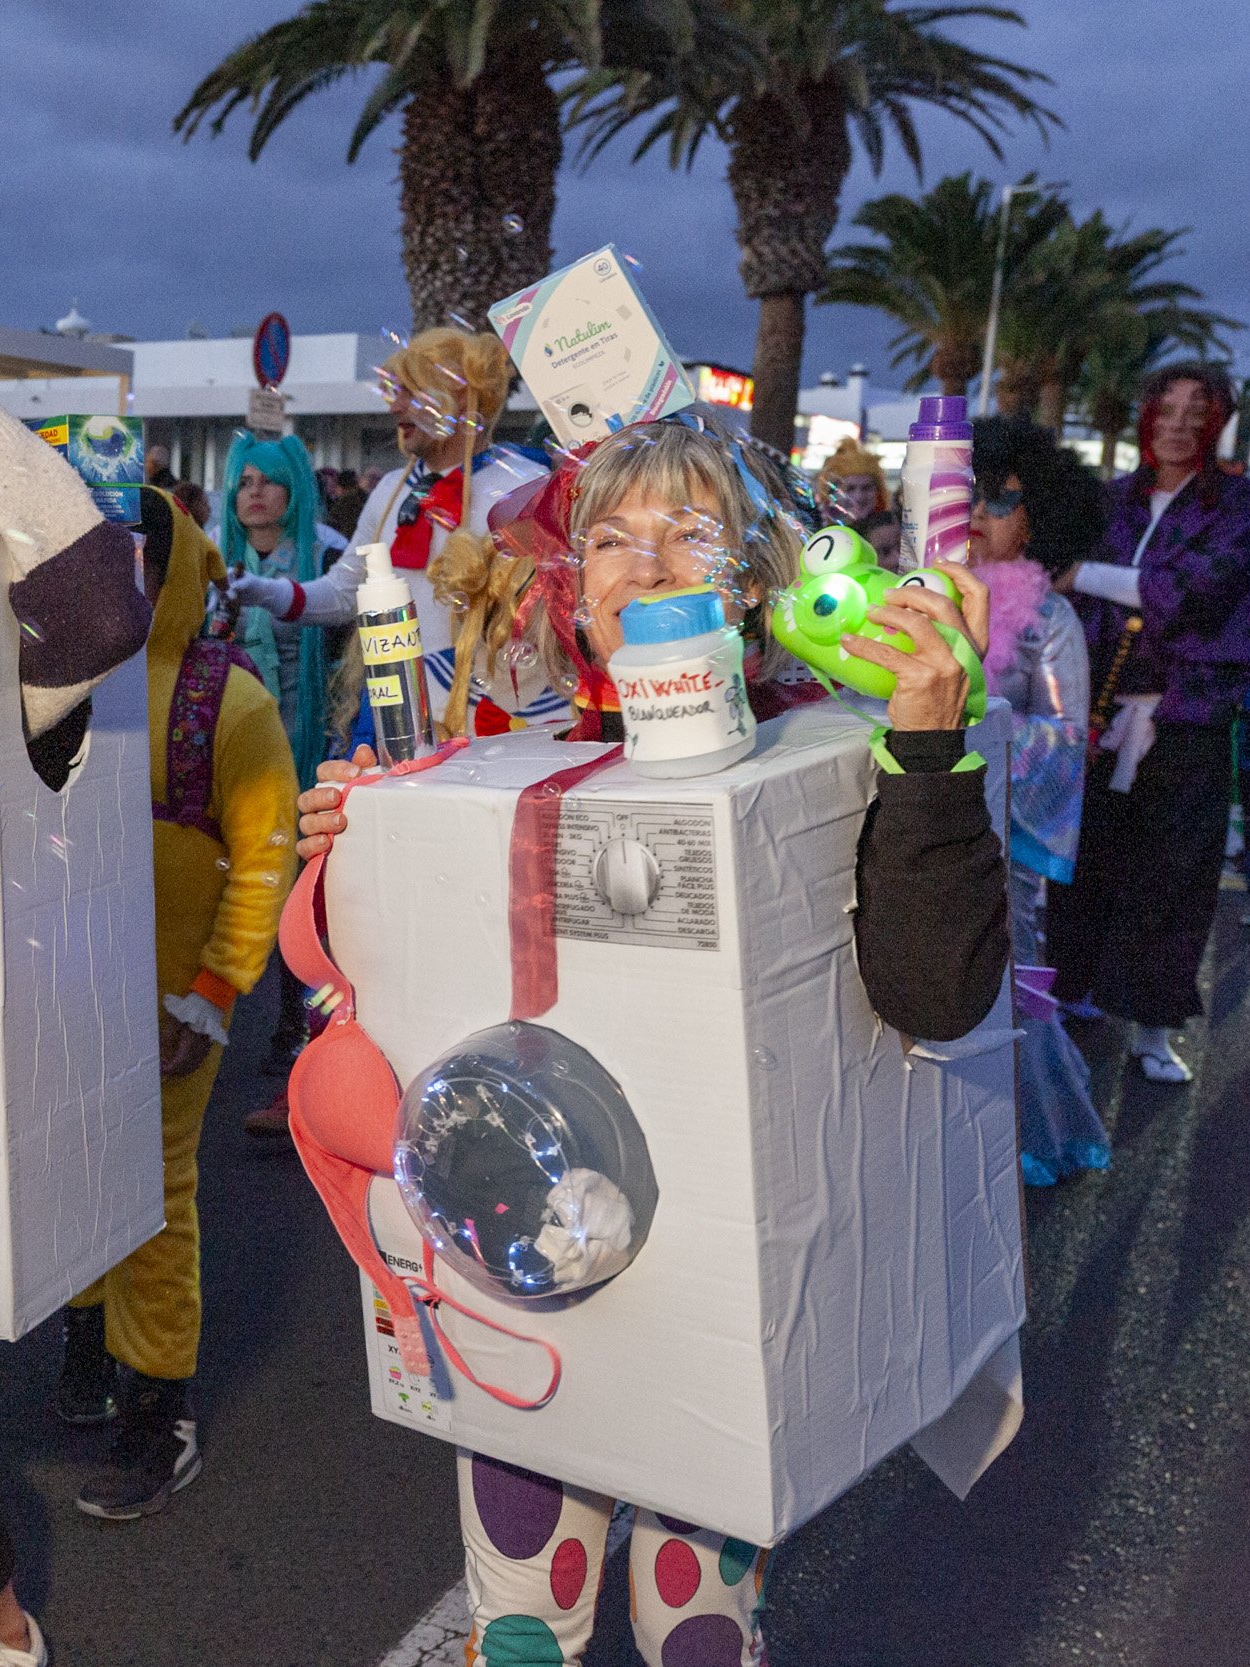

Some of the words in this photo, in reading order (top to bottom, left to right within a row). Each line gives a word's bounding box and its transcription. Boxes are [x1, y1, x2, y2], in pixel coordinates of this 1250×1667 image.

[597, 261, 609, 272] 40
[554, 318, 612, 352] Natulim
[551, 345, 590, 370] Detergente
[589, 340, 600, 350] en
[600, 331, 619, 347] Tiras
[629, 700, 715, 721] BLANQUEADOR
[673, 865, 714, 873] SINTÉTICOS
[387, 1254, 418, 1273] ENERG
